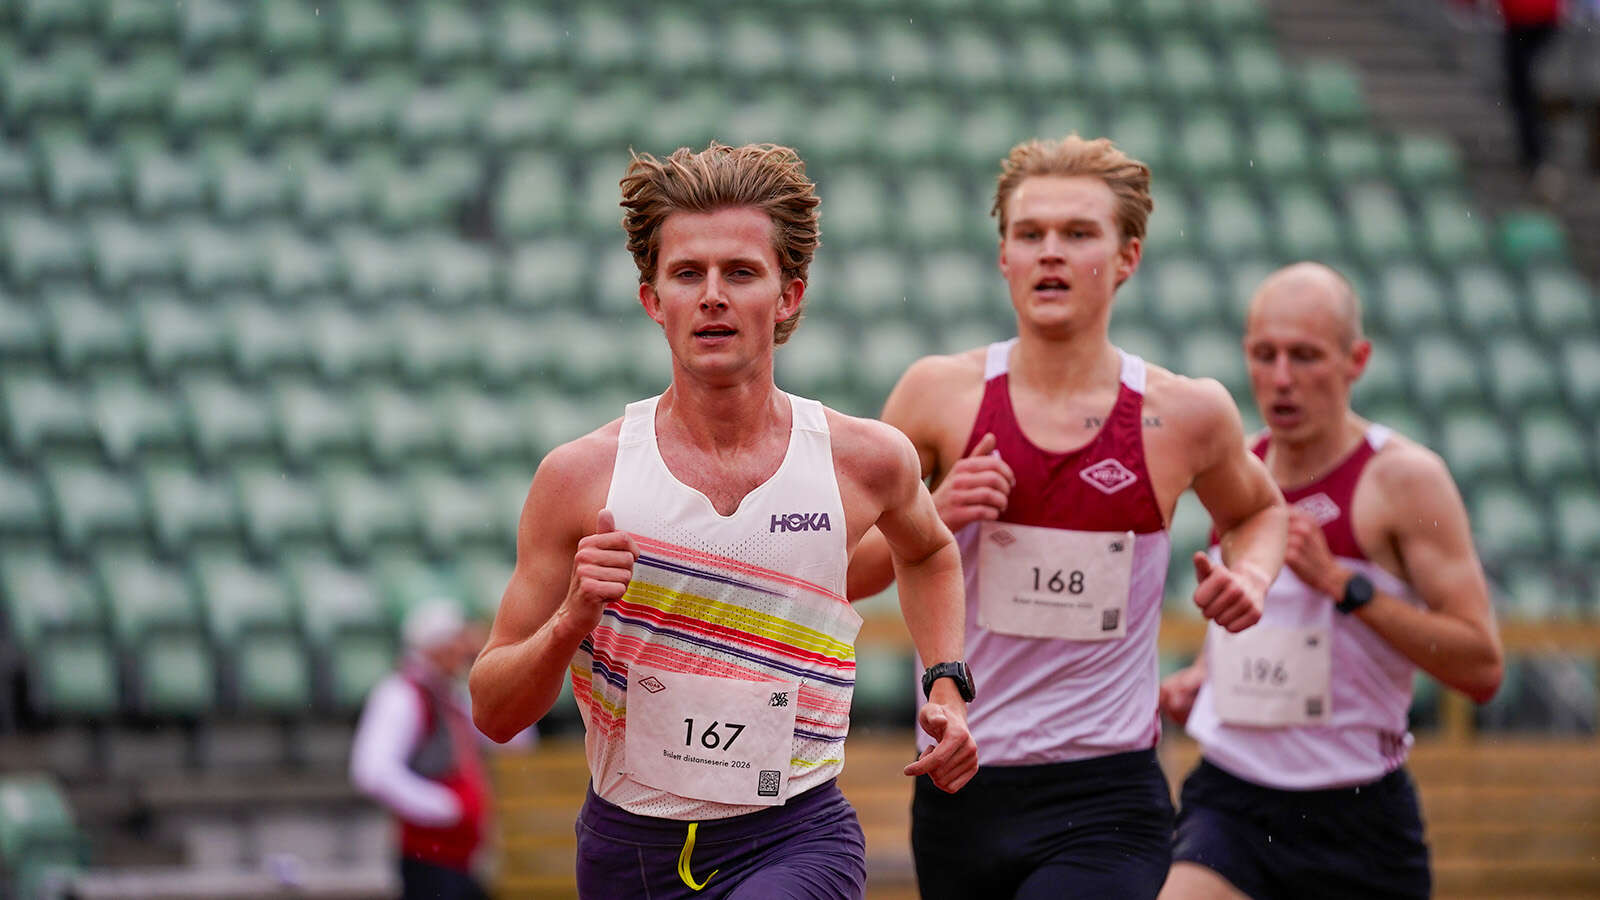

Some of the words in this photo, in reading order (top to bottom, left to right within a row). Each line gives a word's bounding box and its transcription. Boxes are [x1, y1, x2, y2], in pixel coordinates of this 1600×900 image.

[770, 513, 831, 533] HOKA
[1033, 566, 1084, 595] 168
[1242, 656, 1288, 687] 196
[684, 718, 746, 751] 167
[663, 749, 682, 761] Bislett
[683, 755, 729, 767] distanseserie
[731, 760, 751, 769] 2026
